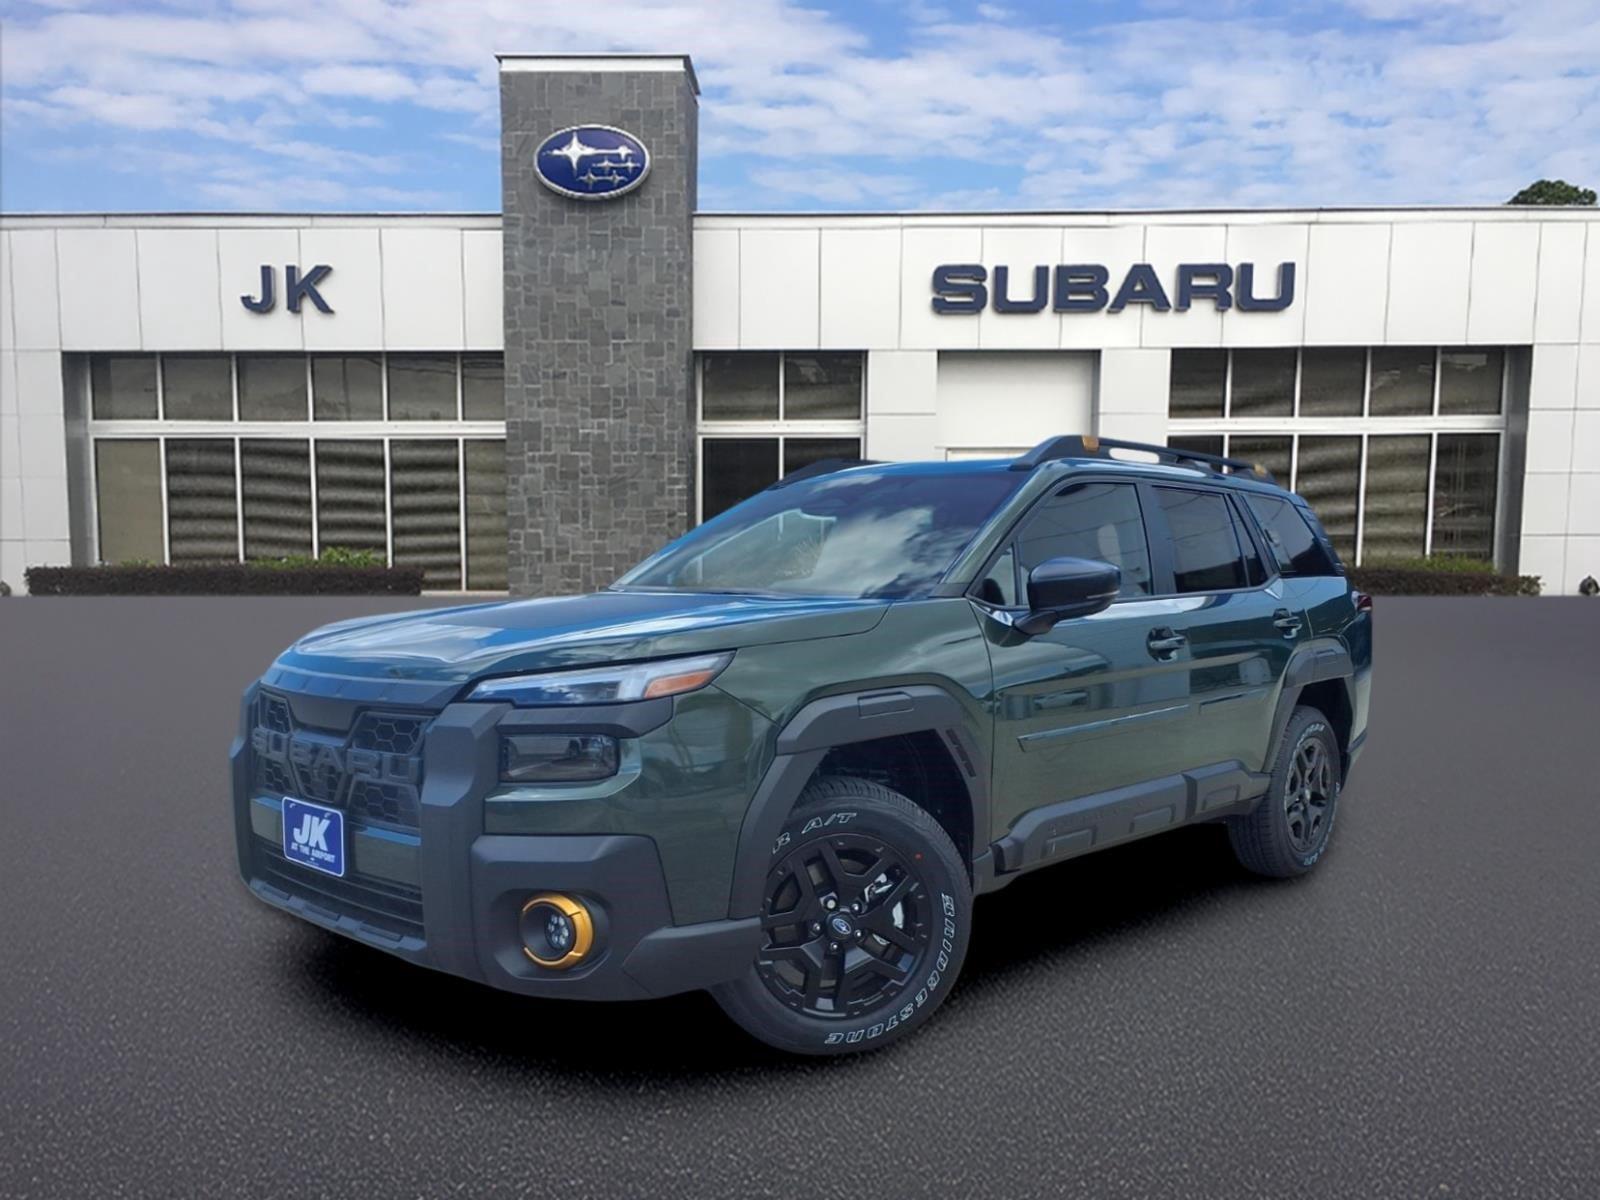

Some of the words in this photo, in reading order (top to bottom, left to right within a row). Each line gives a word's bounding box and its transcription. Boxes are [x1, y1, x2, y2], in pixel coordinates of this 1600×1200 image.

[240, 265, 335, 314] JK
[931, 262, 1296, 314] SUBARU
[251, 727, 422, 784] SUBARU
[293, 813, 331, 851] JK
[801, 812, 857, 834] A/T
[824, 893, 955, 1044] BRIDGESTONE
